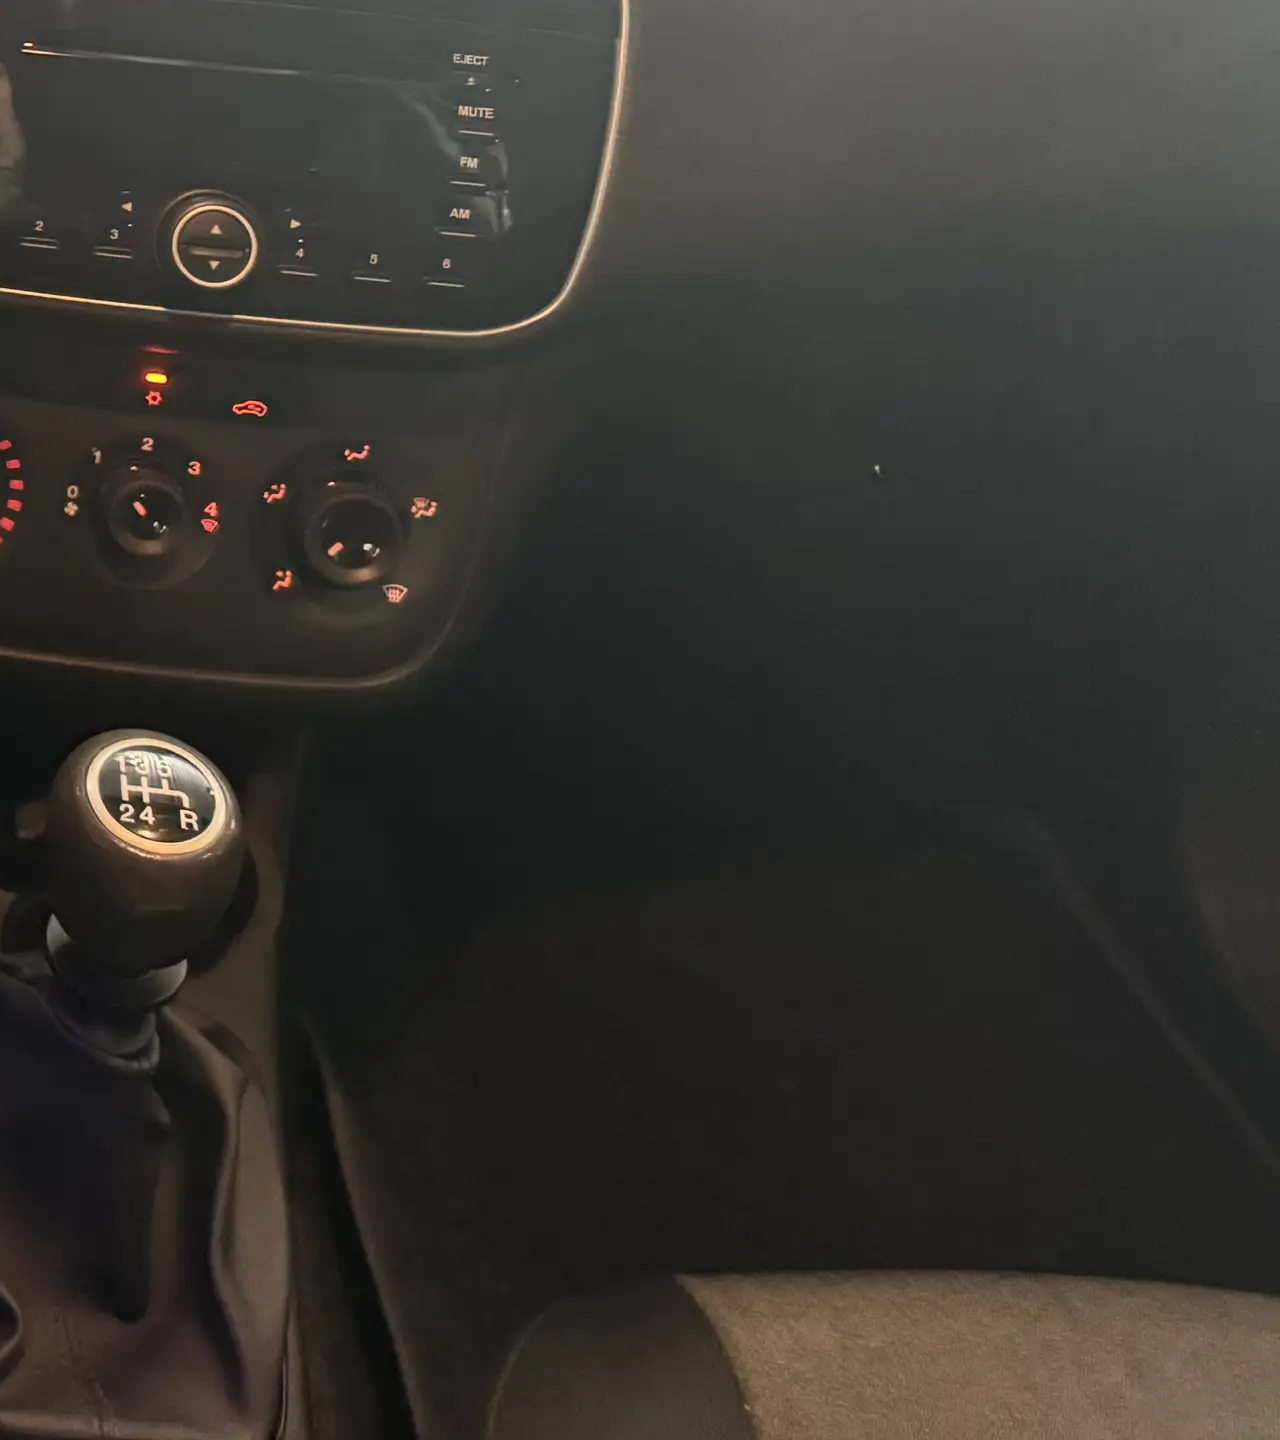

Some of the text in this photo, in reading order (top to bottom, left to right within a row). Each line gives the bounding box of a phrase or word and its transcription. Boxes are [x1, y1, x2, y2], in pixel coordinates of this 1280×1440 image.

[452, 53, 489, 66] EJECT
[457, 104, 496, 119] MUTE
[460, 156, 479, 169] FM
[449, 208, 471, 220] AM
[34, 220, 45, 232] 2
[109, 228, 120, 240] 3
[295, 247, 305, 258] 4
[369, 253, 379, 265] 5
[441, 257, 452, 269] 6
[140, 436, 154, 452] 2
[92, 449, 102, 464] 1
[187, 460, 202, 476] 3
[66, 484, 80, 499] 0
[203, 501, 219, 517] 4
[118, 803, 200, 832] 2 4 R
